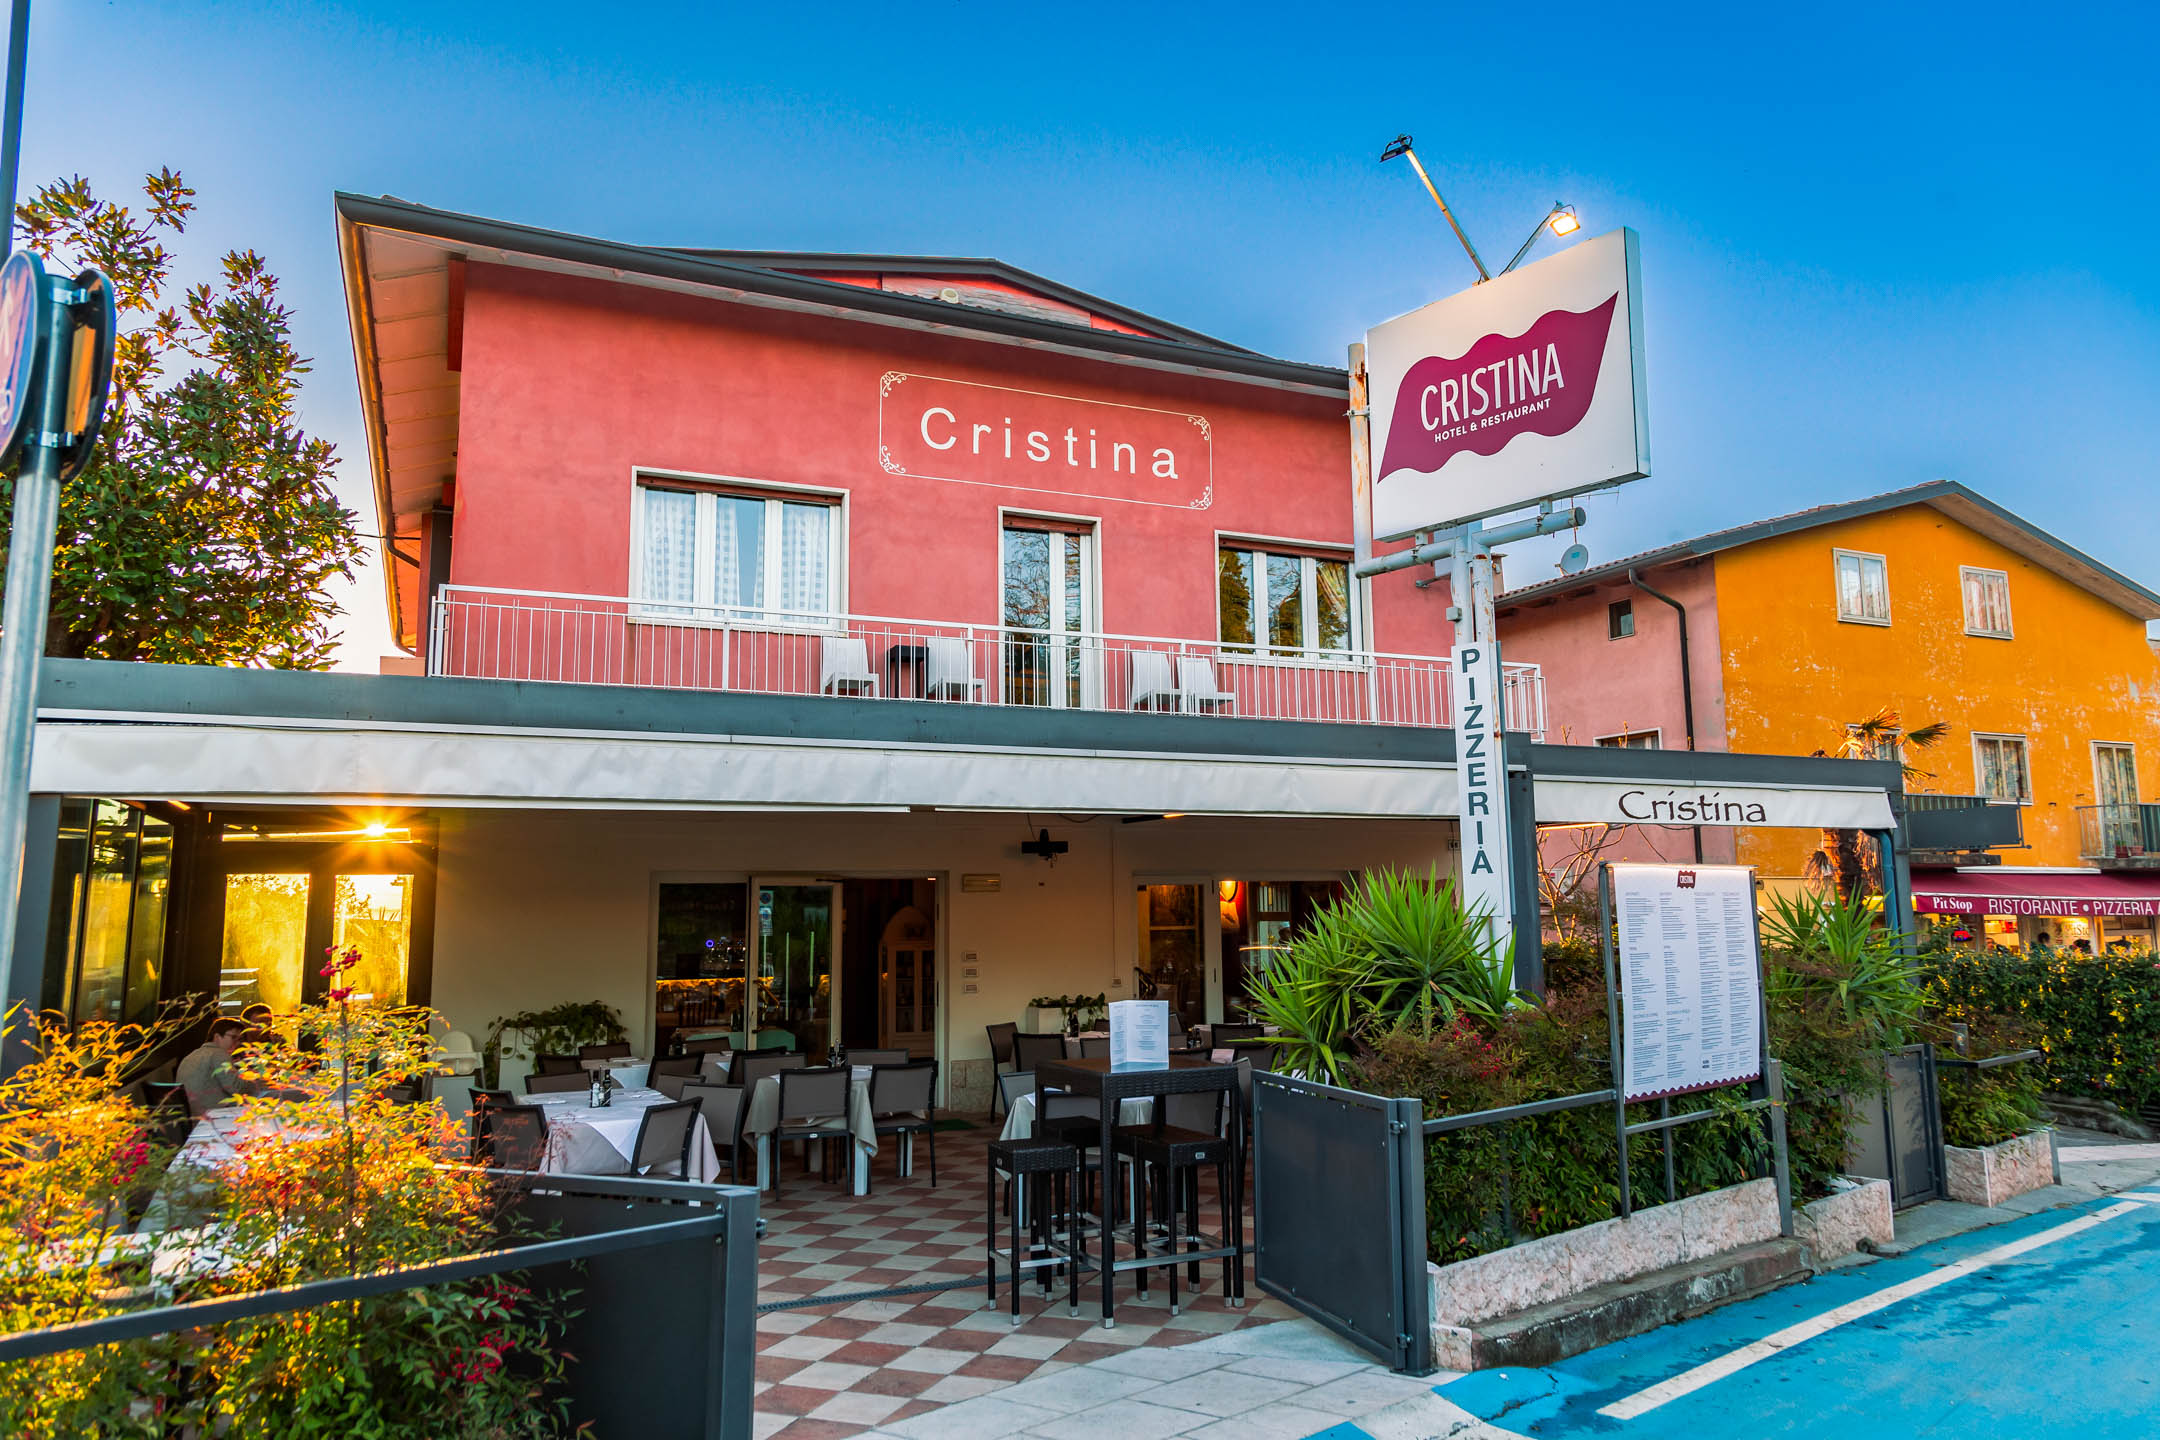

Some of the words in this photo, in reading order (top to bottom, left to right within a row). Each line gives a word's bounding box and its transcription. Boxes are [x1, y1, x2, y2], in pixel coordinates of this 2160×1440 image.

[1420, 343, 1565, 431] CRISTINA
[920, 407, 1179, 480] Cristina
[1434, 425, 1468, 443] HOTEL
[1470, 422, 1478, 431] &
[1480, 398, 1551, 428] RESTAURANT
[1461, 648, 1494, 875] PIZZERIA
[1933, 897, 1948, 909] Pit
[1950, 898, 1973, 913] Stop
[1988, 899, 2079, 916] RISTORANTE
[2093, 901, 2154, 916] PIZZERIA
